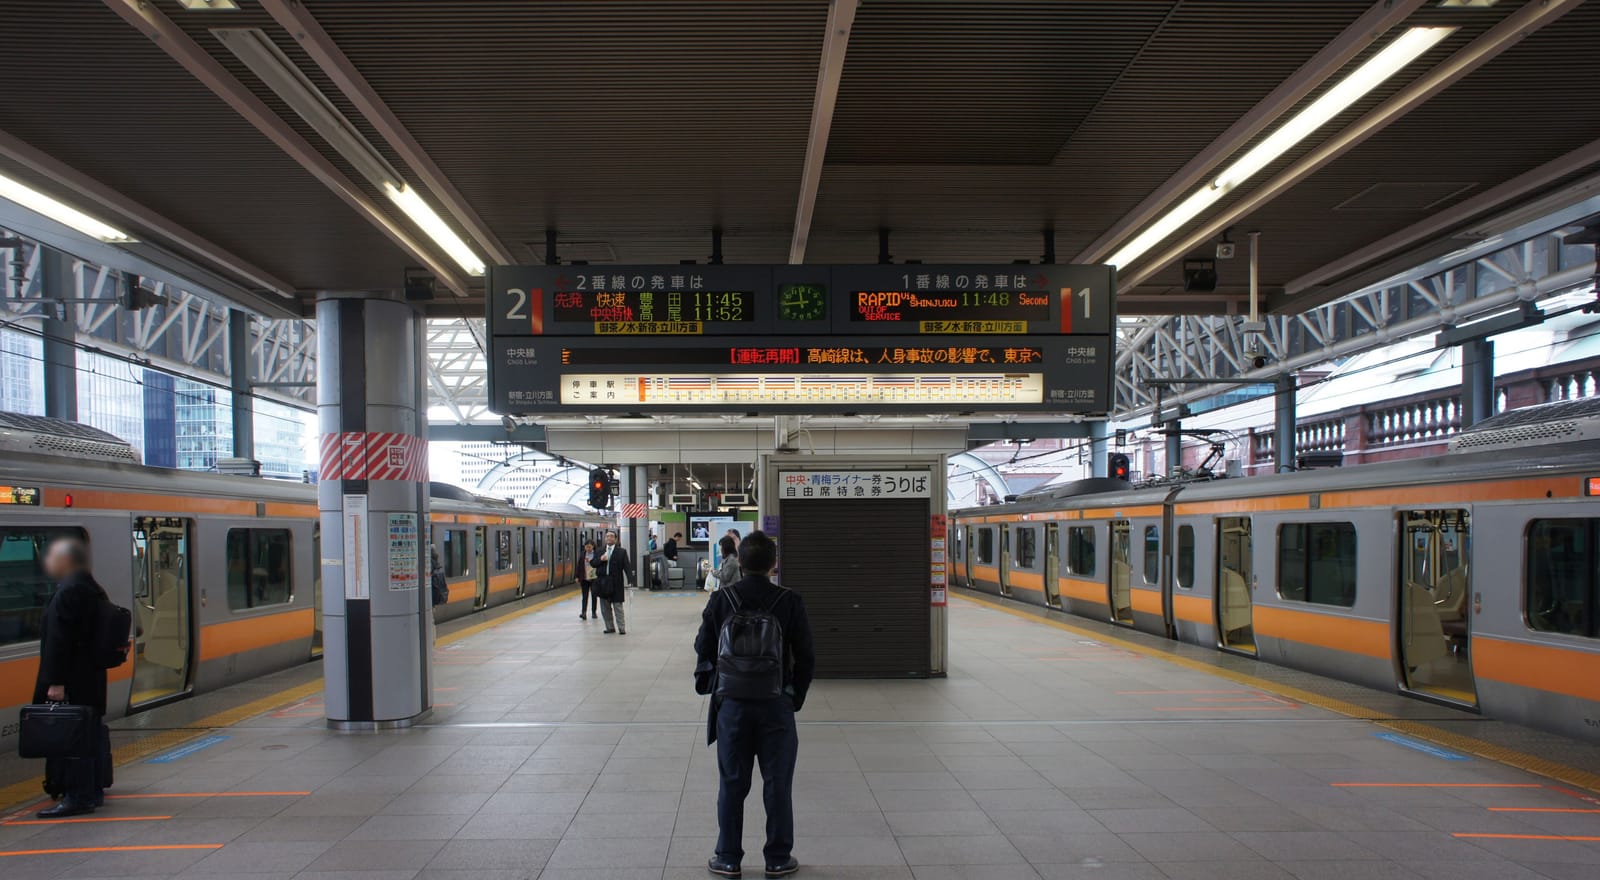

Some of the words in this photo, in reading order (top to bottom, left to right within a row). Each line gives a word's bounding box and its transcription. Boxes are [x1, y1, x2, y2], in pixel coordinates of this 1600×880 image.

[576, 274, 704, 290] 2番線の発車は
[901, 274, 1028, 289] 1番線の発車は
[506, 288, 527, 320] 2
[555, 292, 583, 308] 先発
[596, 292, 625, 307] 快速
[640, 292, 681, 307] 豊田
[694, 292, 743, 307] 11:45
[858, 292, 901, 307] RAPID
[910, 299, 957, 308] SHINJUKU
[962, 292, 1010, 307] 11:48
[1019, 293, 1049, 306] Second
[1078, 288, 1091, 319] 1
[590, 306, 633, 322] 中央特快
[640, 306, 682, 322] 高尾
[694, 307, 743, 321] 11:52
[858, 306, 874, 314] OUT
[876, 306, 888, 314] OF
[865, 313, 900, 321] SERVICE
[507, 348, 535, 358] 中央線
[1067, 346, 1096, 357] 中央線
[572, 380, 615, 389] 停車駅
[785, 473, 882, 486] 中央・青梅ライナー券
[884, 475, 928, 493] うりば
[786, 485, 882, 497] 自由席特急券
